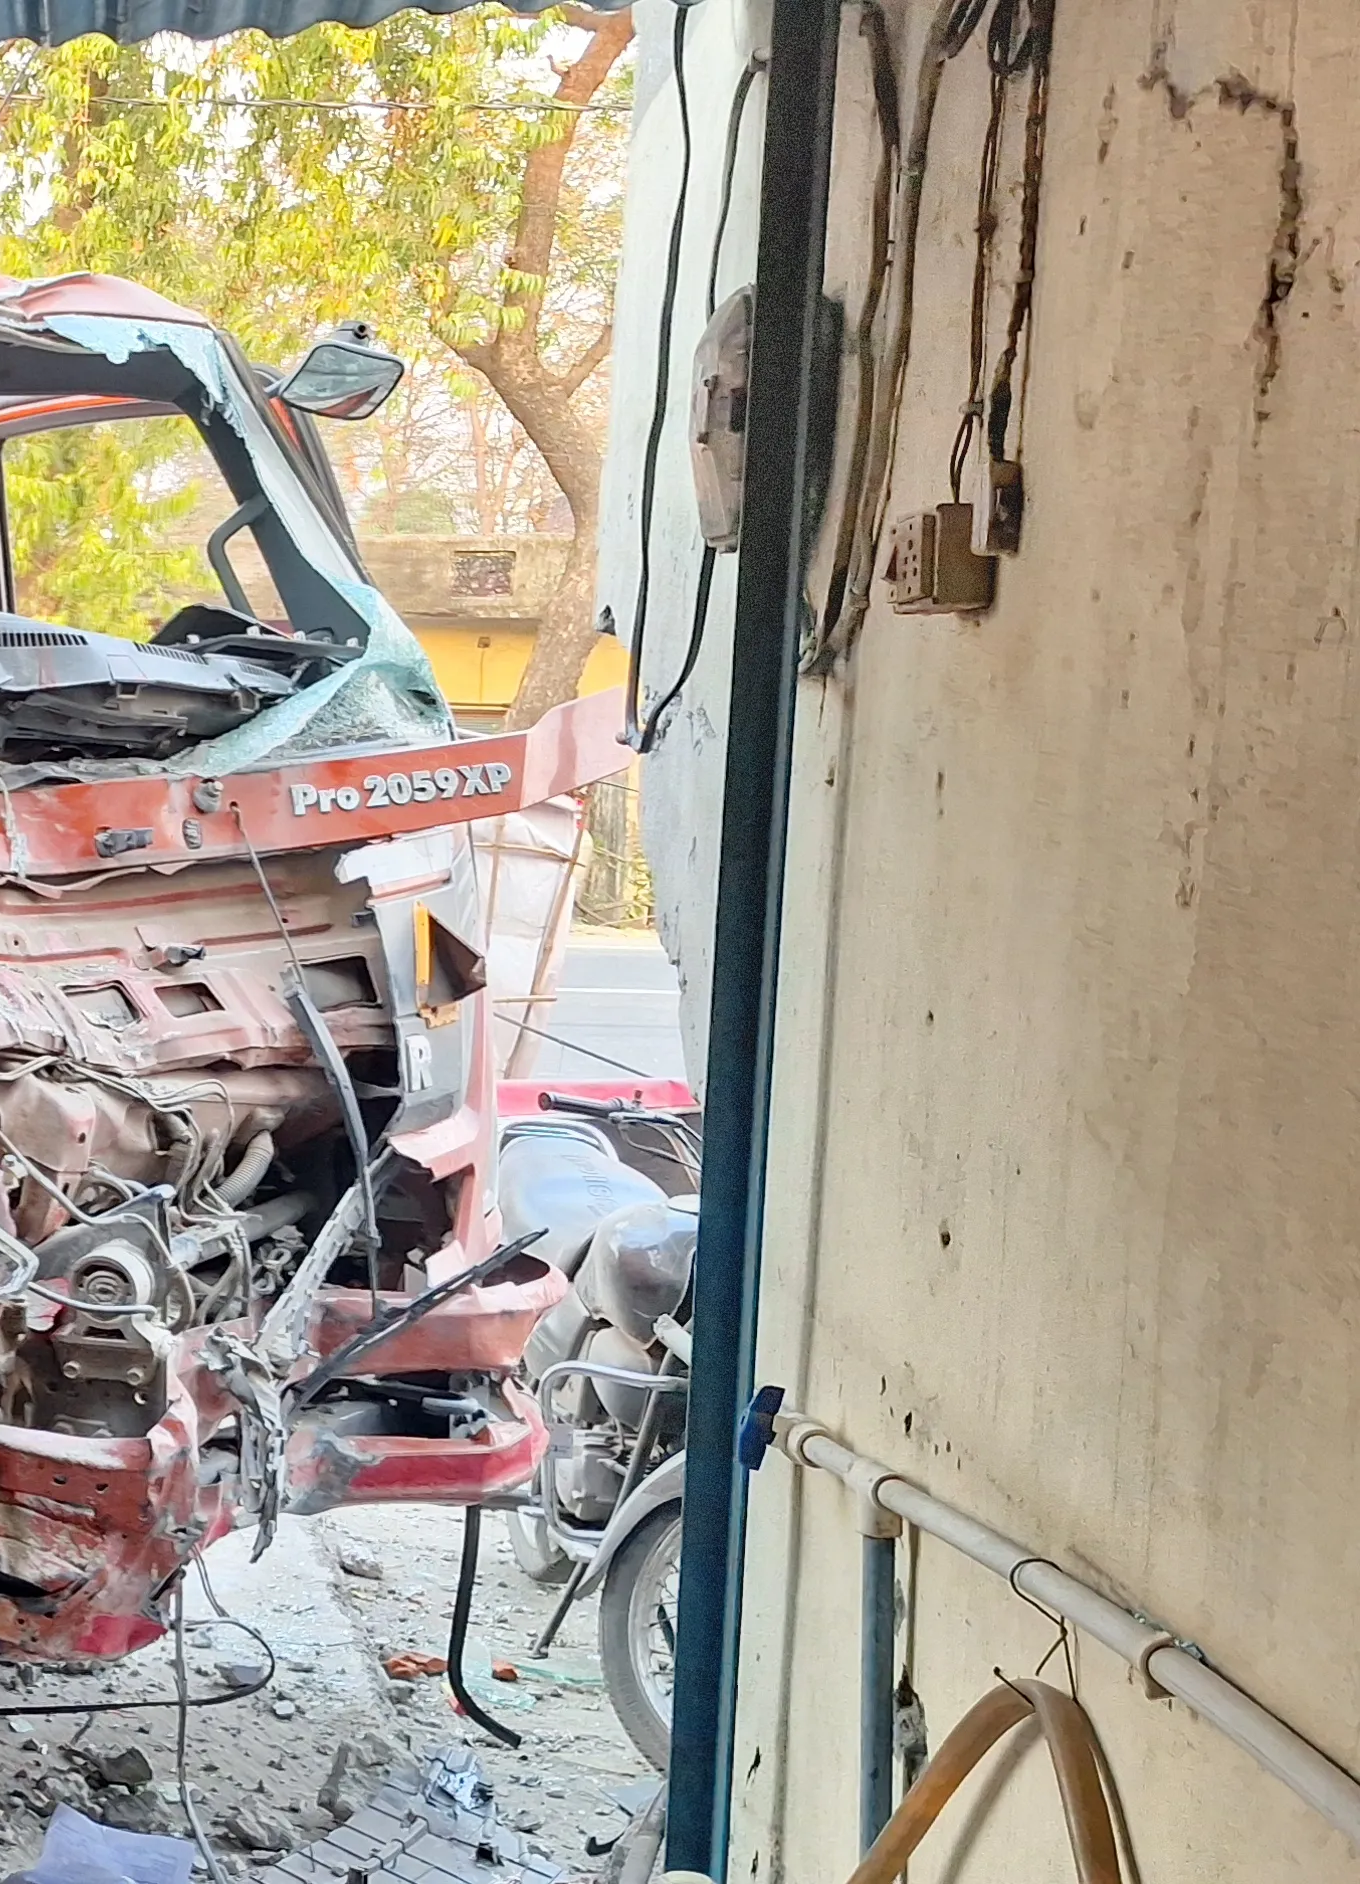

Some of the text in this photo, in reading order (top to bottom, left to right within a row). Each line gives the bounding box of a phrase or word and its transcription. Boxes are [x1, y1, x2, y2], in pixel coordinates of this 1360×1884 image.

[291, 762, 513, 816] Pro 2059XP
[406, 1033, 433, 1093] R
